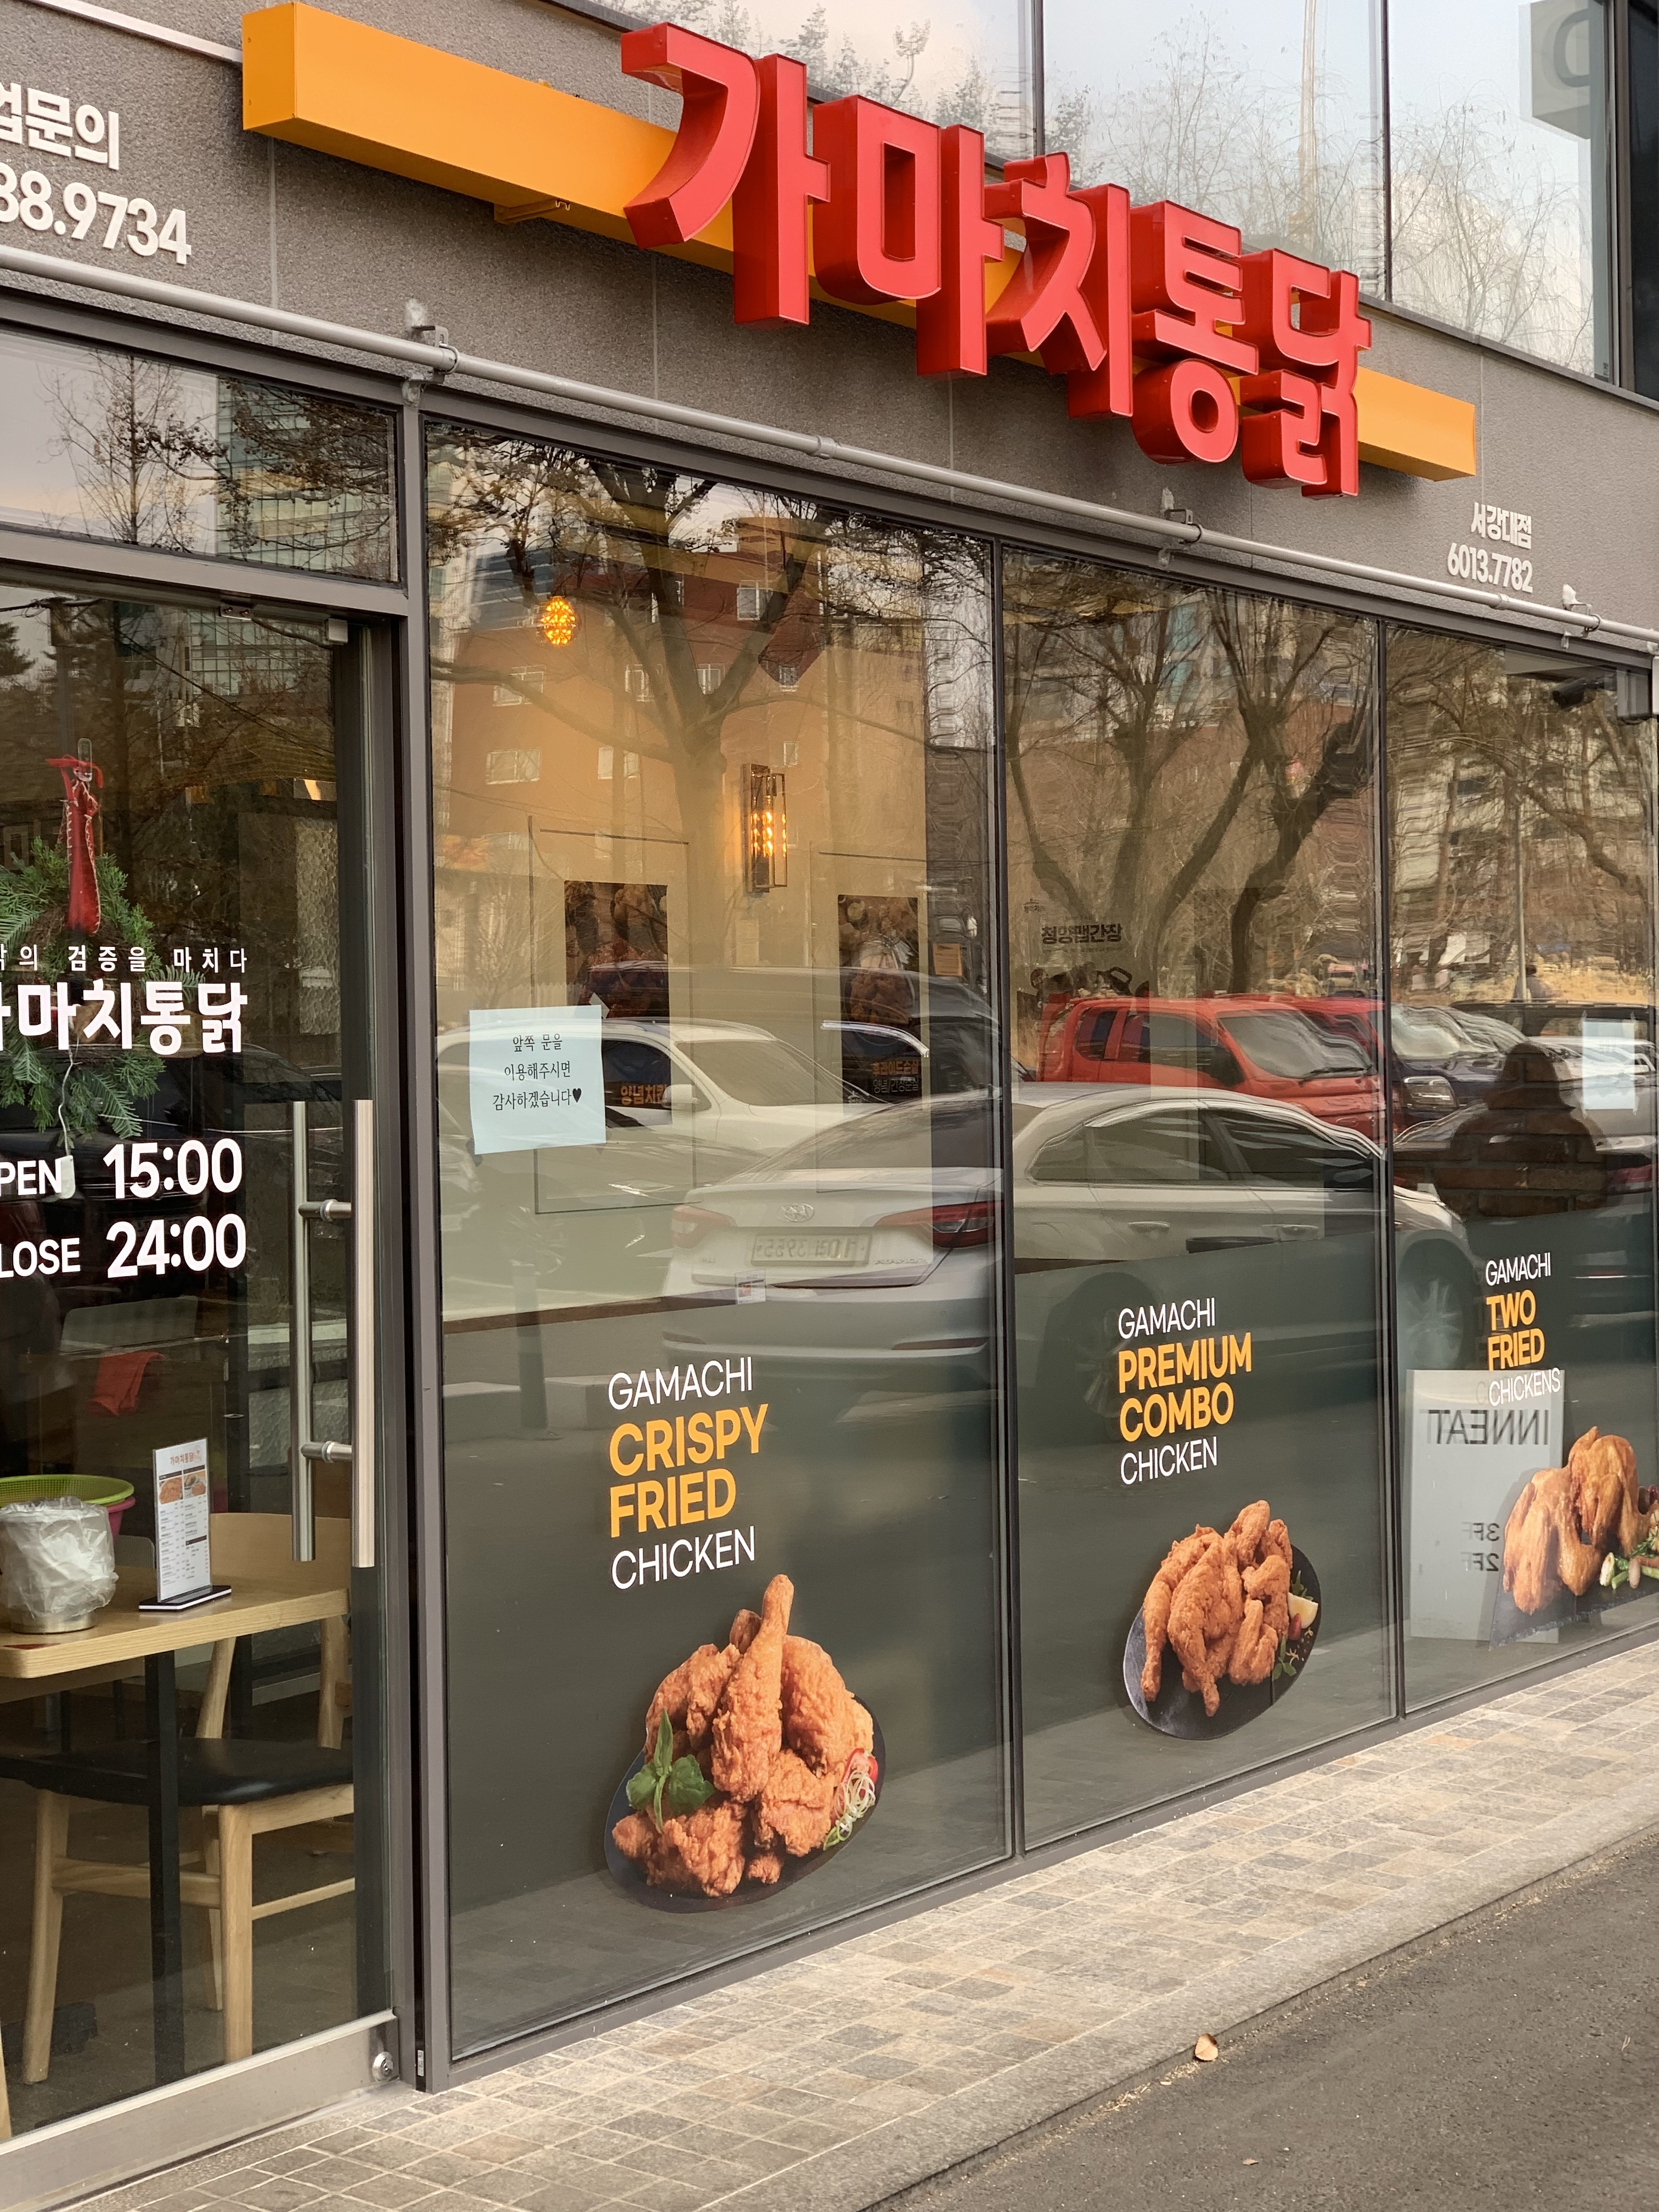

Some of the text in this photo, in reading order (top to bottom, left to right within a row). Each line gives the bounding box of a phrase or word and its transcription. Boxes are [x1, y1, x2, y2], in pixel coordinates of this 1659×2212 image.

[622, 22, 1372, 498] 가마치통닭
[1471, 502, 1532, 550] 서강대점
[1447, 537, 1533, 593] 6013.7782
[68, 945, 147, 972] 검증을
[173, 947, 247, 973] 마치다
[0, 978, 248, 1056] 마치통닭
[512, 1033, 563, 1052] 앞쪽 문을
[504, 1060, 571, 1081] 이용해주시면
[103, 1138, 242, 1199] 15:00
[106, 1214, 246, 1278] 24:00
[1486, 1252, 1551, 1286] GAMACHI
[1118, 1297, 1216, 1339] GAMACHI
[1486, 1290, 1536, 1331] TWO
[1119, 1332, 1252, 1393] PREMIUM
[1488, 1328, 1545, 1372] FRIED
[608, 1356, 753, 1410] GAMACHI
[1489, 1368, 1561, 1406] CHICKENS
[1120, 1382, 1234, 1442] COMBO
[609, 1403, 768, 1477] CRISPY
[1120, 1436, 1218, 1485] CHICKEN
[610, 1468, 736, 1538] FRIED
[612, 1526, 755, 1590] CHICKEN
